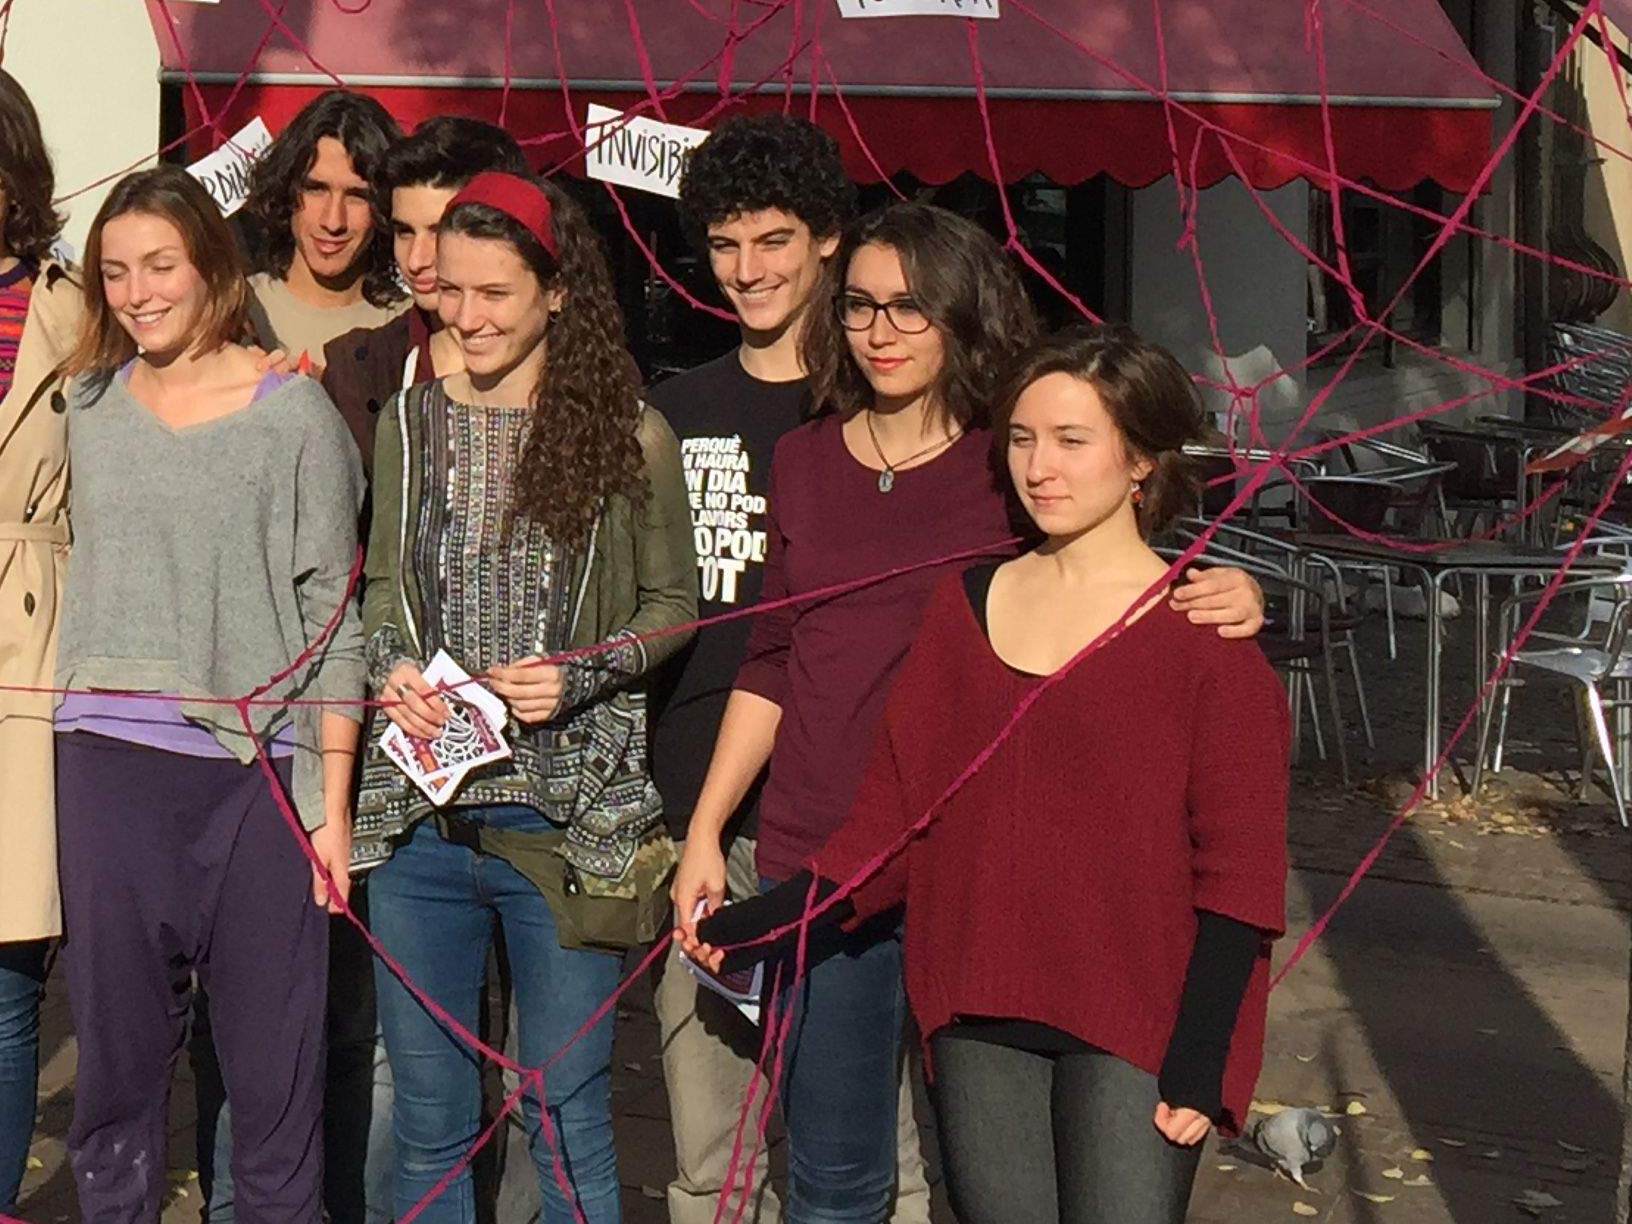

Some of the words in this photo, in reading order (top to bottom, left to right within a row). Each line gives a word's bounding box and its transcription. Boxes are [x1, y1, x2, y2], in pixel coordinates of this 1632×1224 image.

[707, 469, 747, 494] DIA
[704, 491, 728, 511] NO
[696, 555, 746, 604] OT
